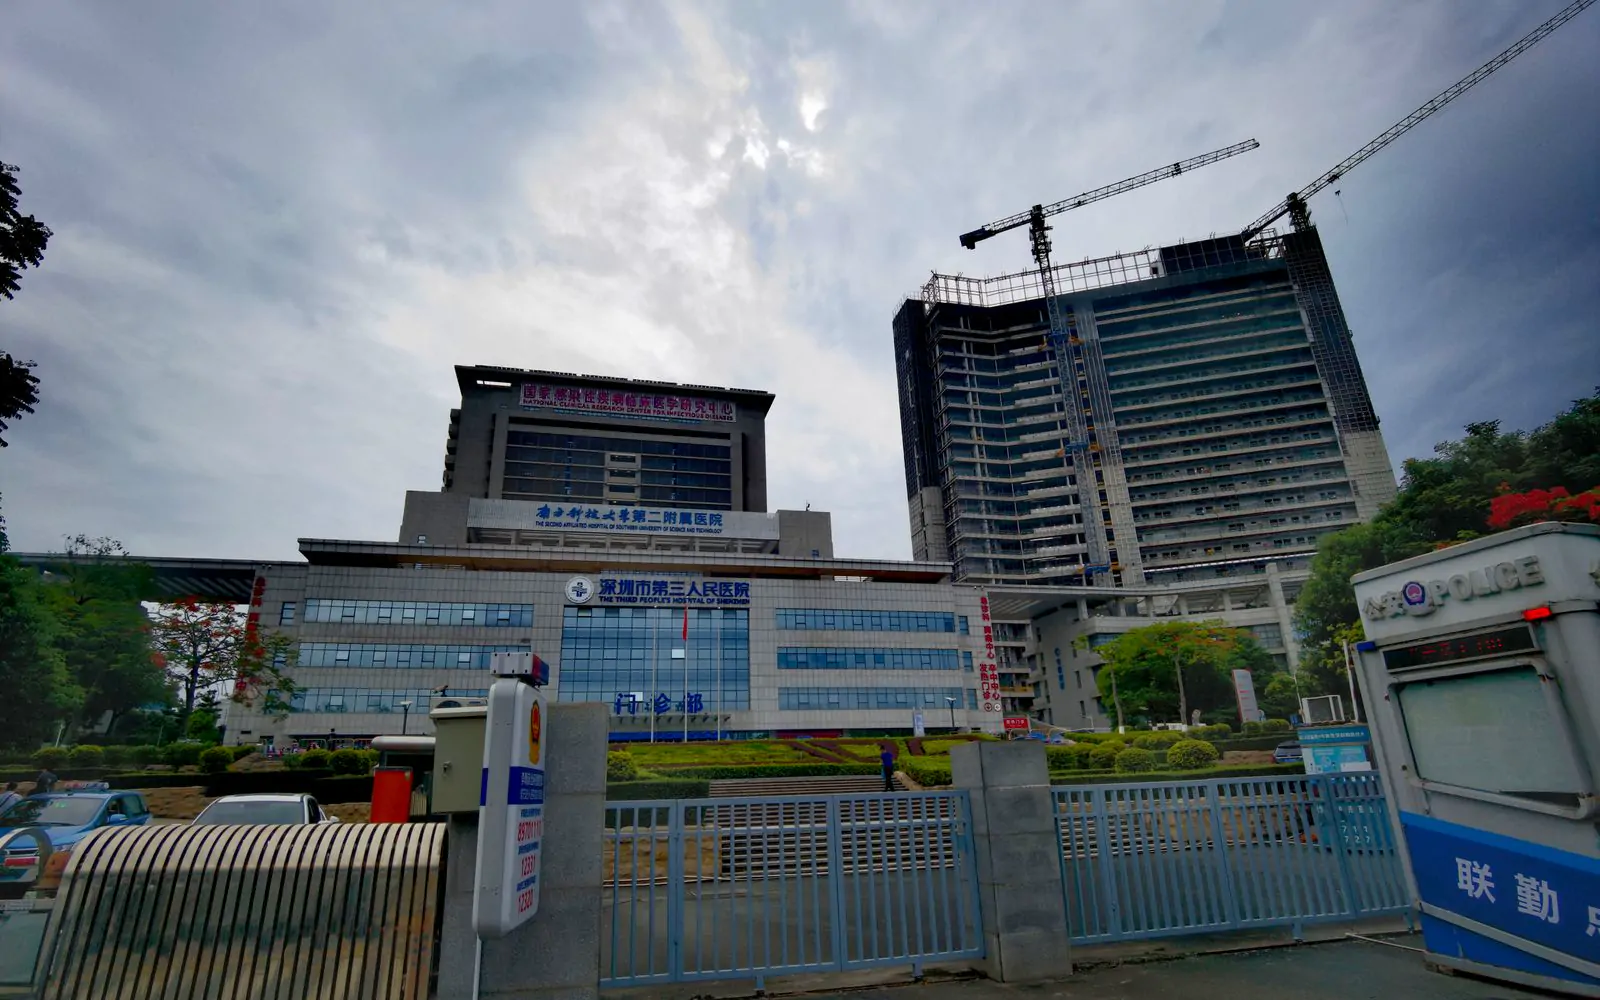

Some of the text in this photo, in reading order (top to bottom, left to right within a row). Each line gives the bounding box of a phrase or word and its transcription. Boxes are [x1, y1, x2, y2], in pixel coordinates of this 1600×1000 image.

[523, 399, 558, 407] NATIONAL
[592, 404, 625, 412] RESEARCH
[536, 504, 722, 526] 南方科技大学第二附属医院
[599, 579, 750, 598] 深圳市第三人民医院
[1427, 555, 1545, 607] POLICE
[615, 692, 703, 715] 门诊部
